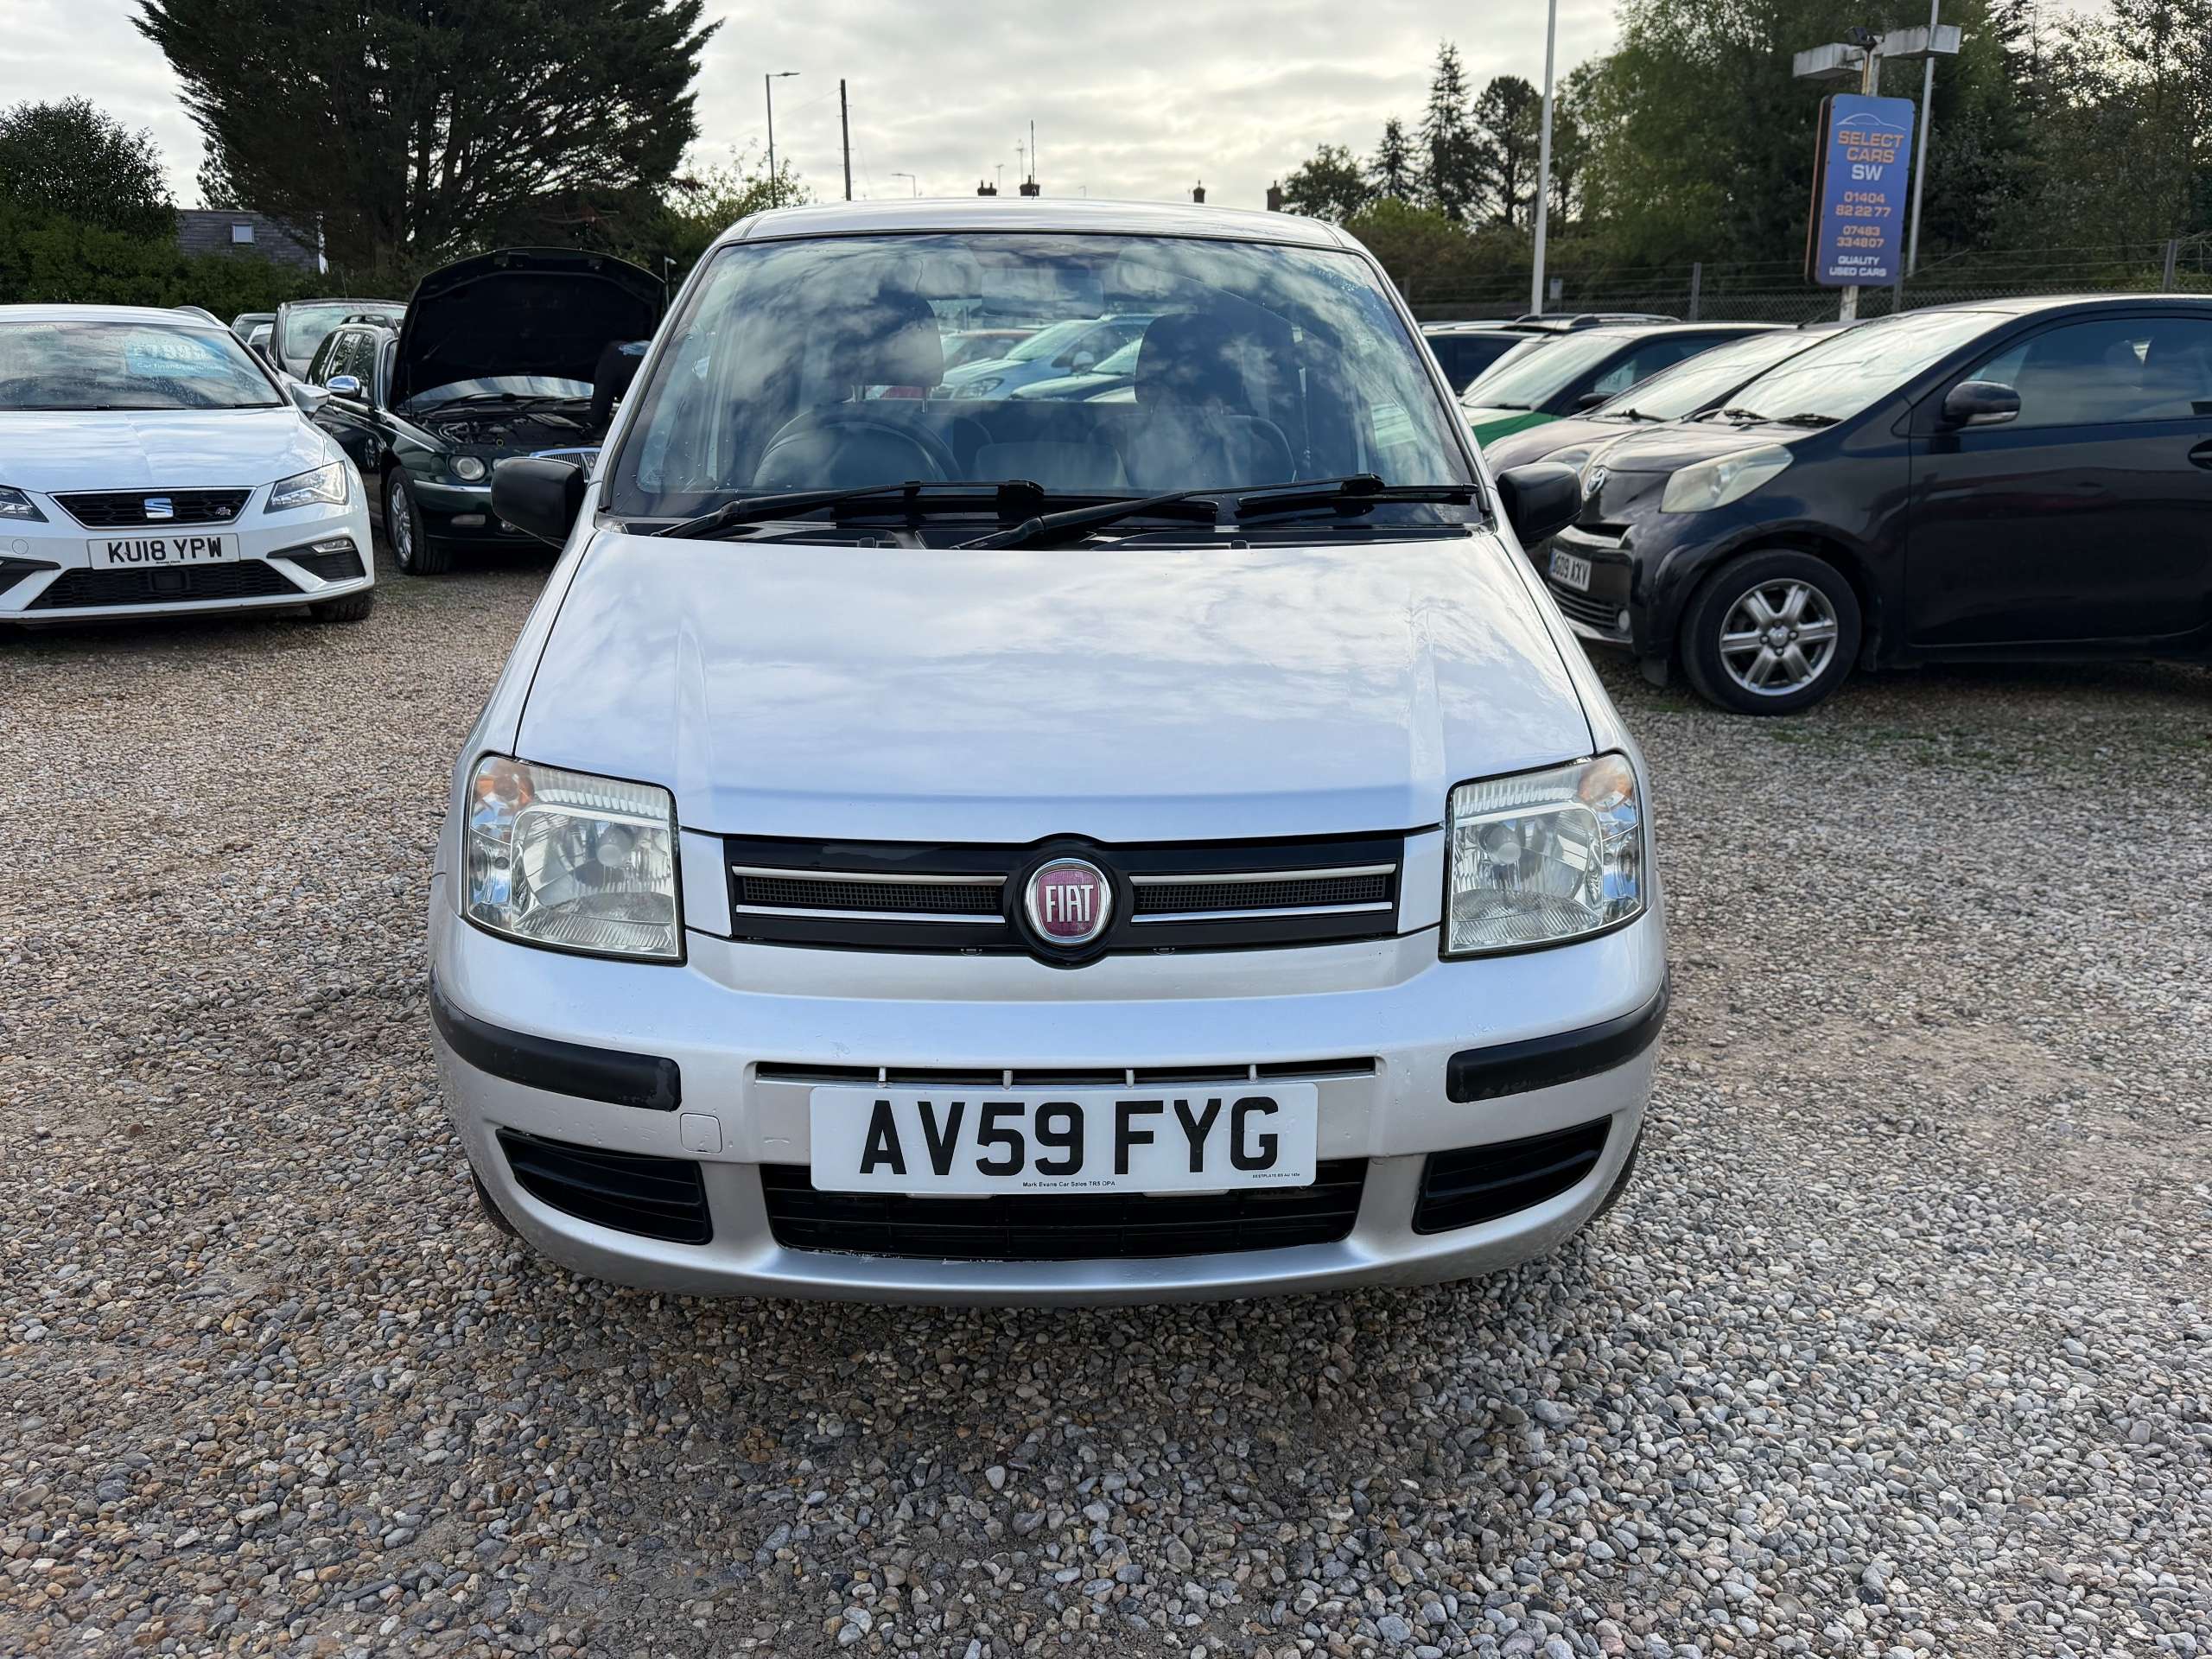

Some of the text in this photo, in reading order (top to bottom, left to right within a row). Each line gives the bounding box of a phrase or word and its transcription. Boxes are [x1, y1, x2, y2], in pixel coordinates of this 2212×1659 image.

[1838, 130, 1904, 148] SELECT
[1847, 148, 1895, 163] CARS
[1851, 164, 1883, 181] SW
[1843, 191, 1885, 204] 01404
[1837, 255, 1880, 265] QUALITY
[1828, 266, 1887, 277] USED CARS
[107, 537, 222, 563] KU18 YPW
[1045, 884, 1094, 923] FIAT
[859, 1096, 1280, 1177] AV59 FYG
